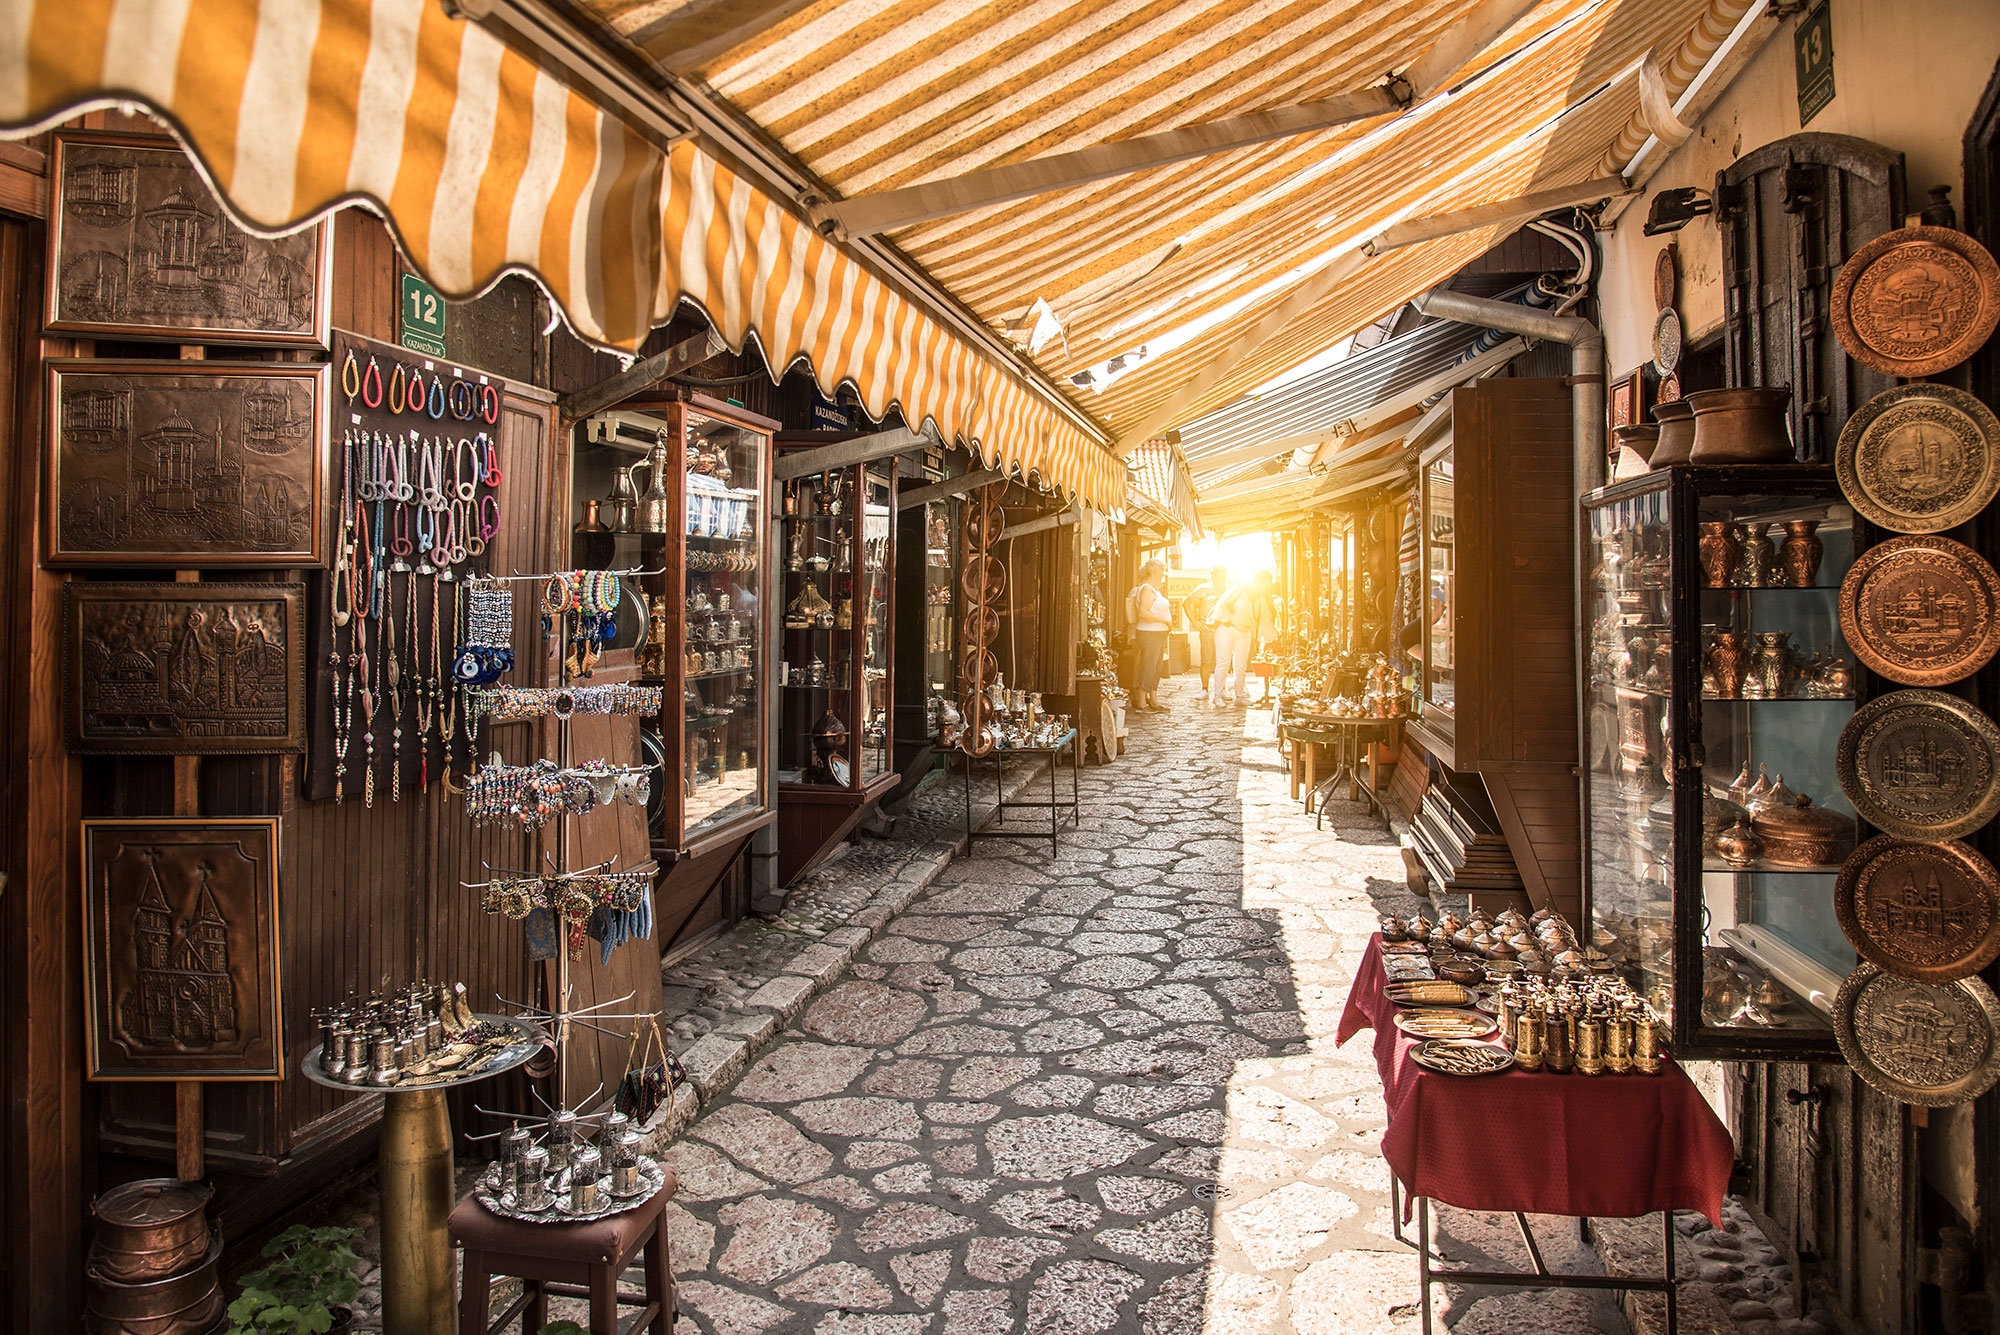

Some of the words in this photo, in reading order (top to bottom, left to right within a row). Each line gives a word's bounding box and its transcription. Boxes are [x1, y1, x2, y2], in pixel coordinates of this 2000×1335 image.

[1802, 25, 1822, 74] 13
[411, 289, 437, 325] 12
[406, 338, 442, 356] KAZANDŽILUK
